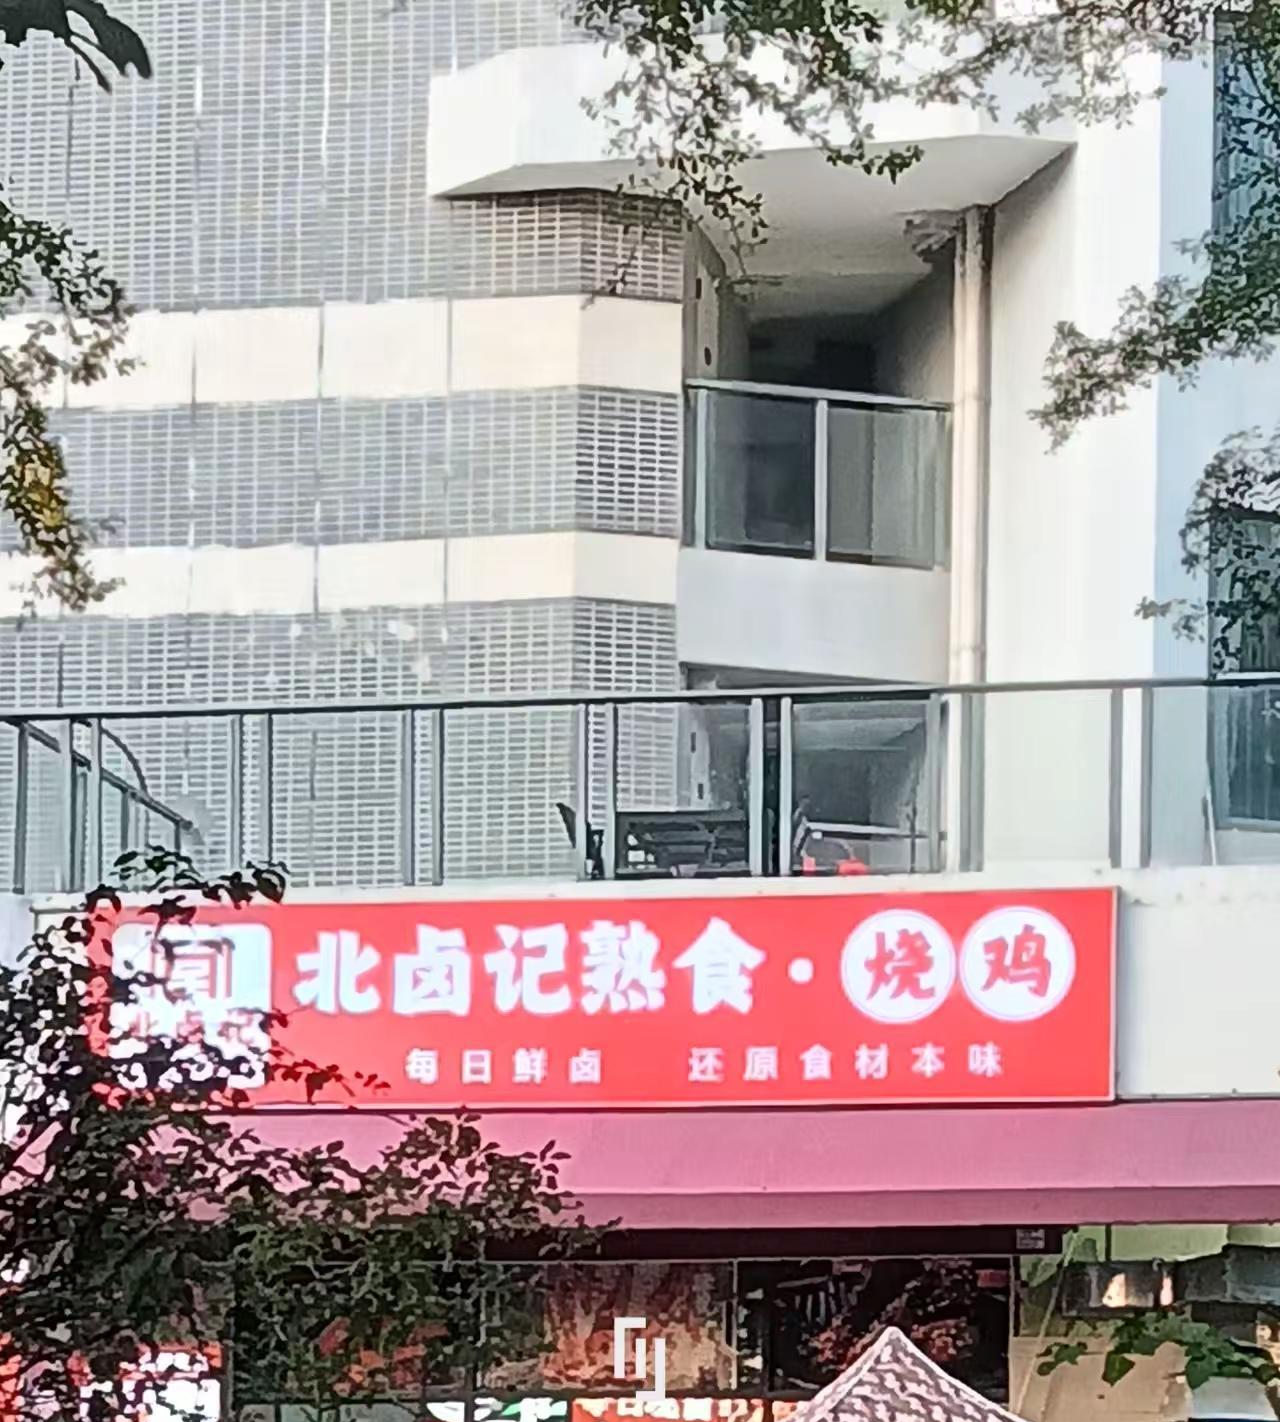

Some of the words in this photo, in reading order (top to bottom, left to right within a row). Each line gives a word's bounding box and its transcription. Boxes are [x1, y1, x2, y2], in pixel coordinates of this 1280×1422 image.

[404, 1047, 602, 1085] 每日鲜卤
[687, 1041, 1004, 1082] 还原食材本味
